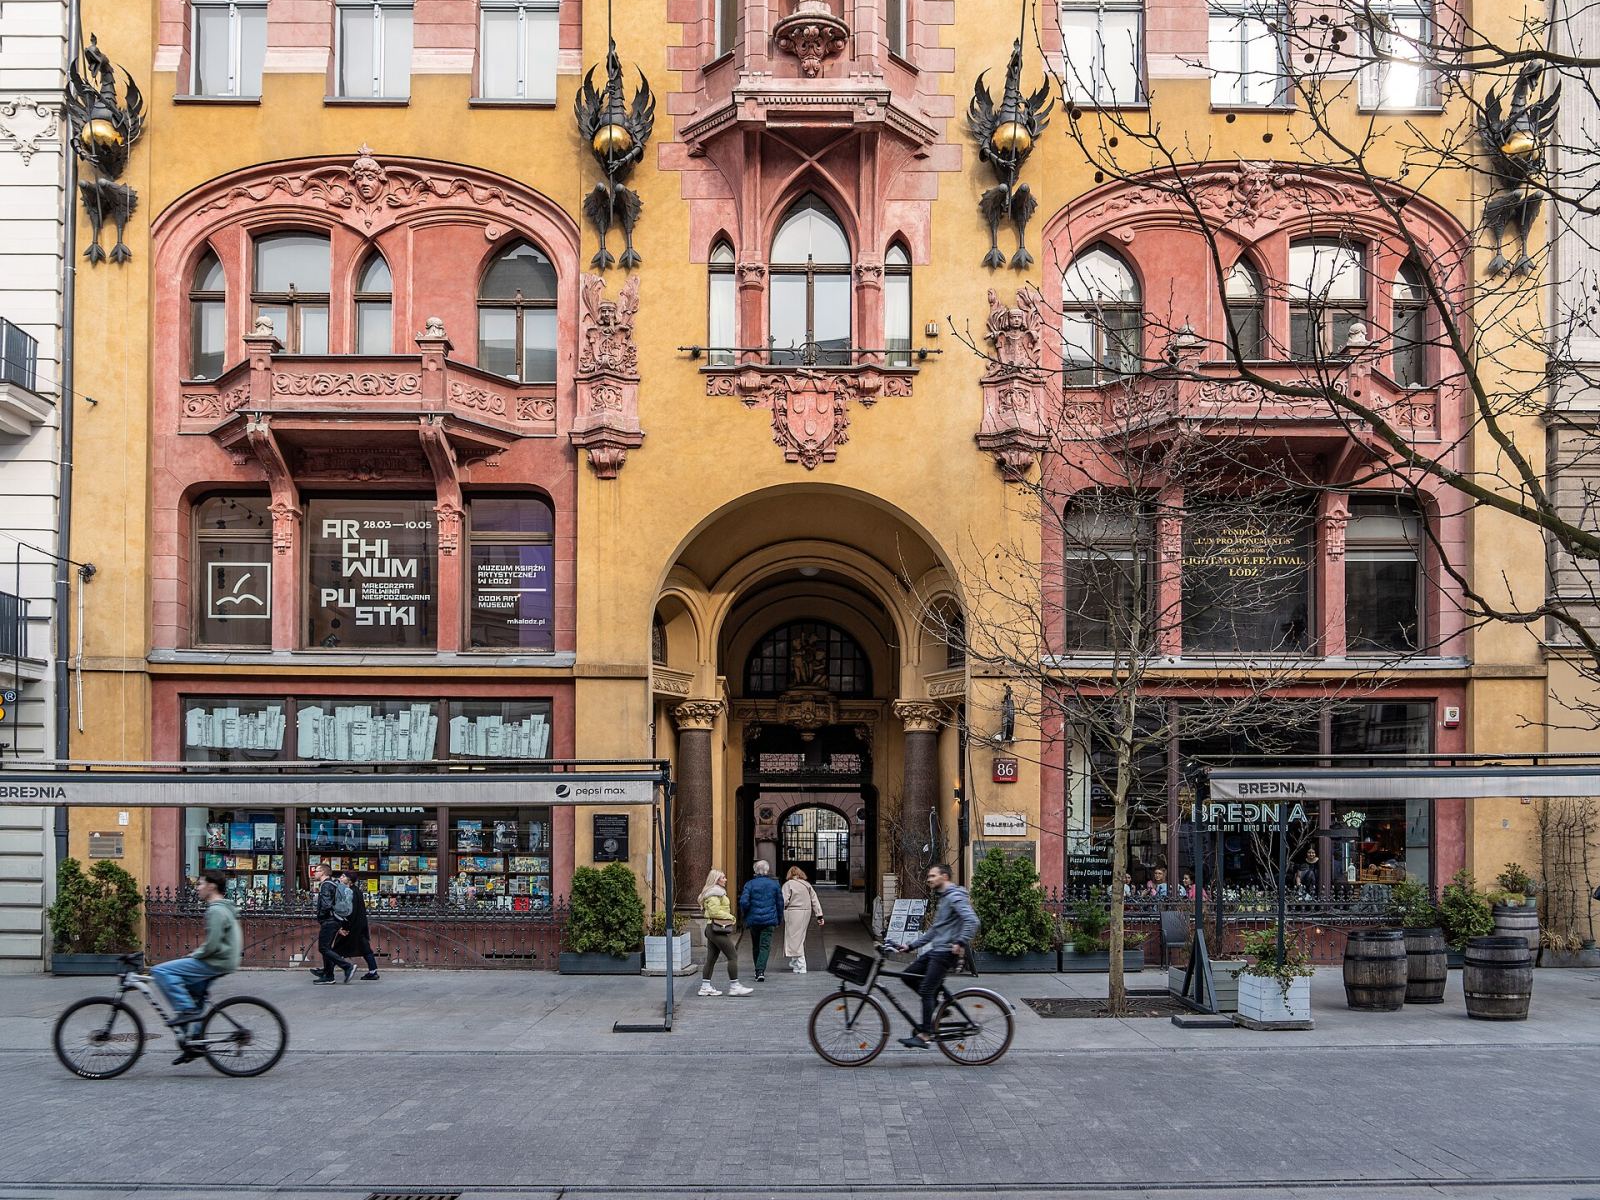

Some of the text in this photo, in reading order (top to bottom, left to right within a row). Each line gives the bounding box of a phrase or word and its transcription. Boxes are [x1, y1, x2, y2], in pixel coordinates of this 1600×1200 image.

[322, 519, 360, 538] AR
[342, 539, 389, 558] CHI
[342, 558, 417, 578] WUM
[515, 564, 546, 572] KSIĄŻKI
[1229, 566, 1259, 576] ŁÓDŹ
[321, 588, 356, 608] PU
[355, 606, 416, 626] STKI
[506, 618, 546, 626] mkalodz.pl
[997, 763, 1014, 776] 86
[0, 786, 67, 798] BREDNIA
[575, 787, 626, 797] pepsi max
[1238, 782, 1307, 794] BREDNIA
[1191, 803, 1308, 823] BREDNA
